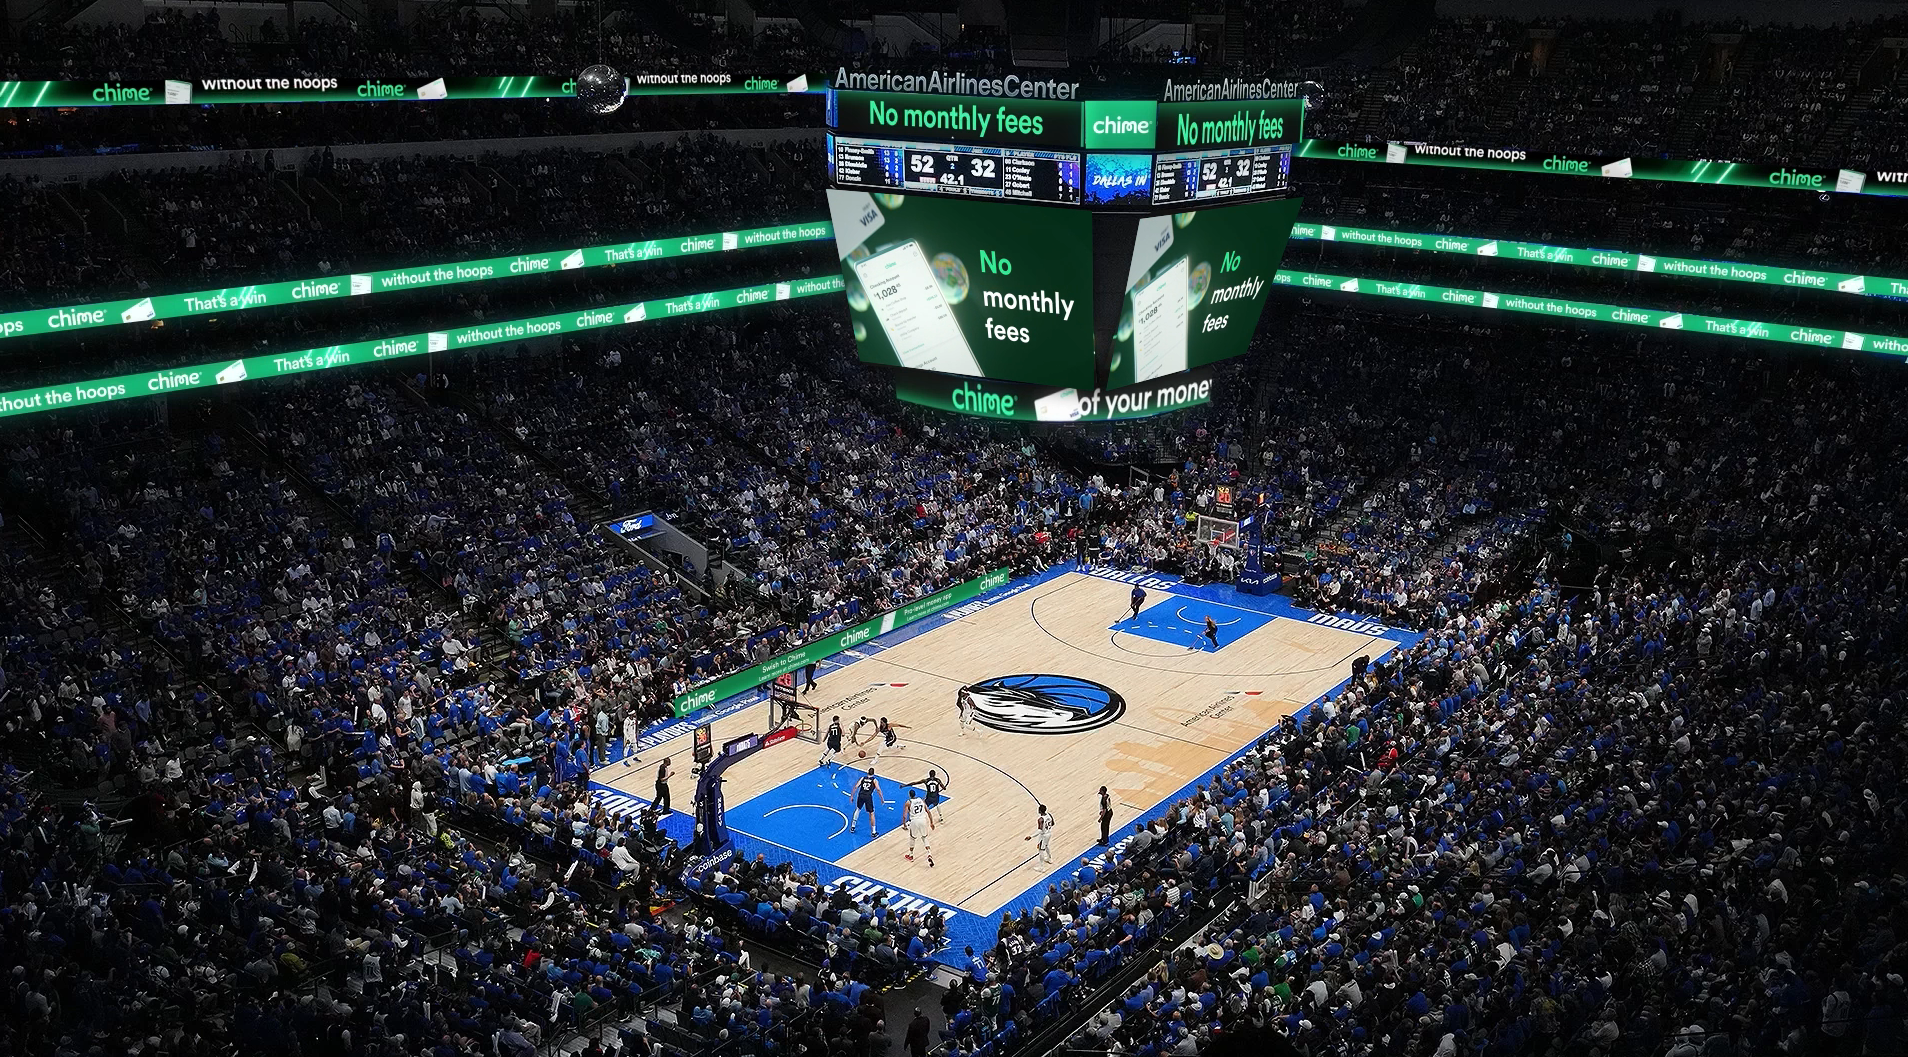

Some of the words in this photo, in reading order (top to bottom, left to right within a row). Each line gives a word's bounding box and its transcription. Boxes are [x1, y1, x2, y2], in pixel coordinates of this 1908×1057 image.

[202, 78, 262, 90] without
[266, 77, 290, 90] the
[293, 76, 338, 91] hoops
[637, 75, 678, 85] without
[681, 74, 698, 84] the
[700, 73, 731, 86] hoops
[744, 77, 778, 90] chime
[835, 67, 1079, 99] AmericanAirlinesCenter
[92, 83, 151, 102] chime
[357, 80, 404, 97] chime
[1163, 78, 1299, 102] AmericanAirlinesCenter
[869, 100, 898, 126] No
[904, 104, 991, 137] monthly
[996, 106, 1043, 135] fees
[1093, 116, 1150, 134] chime
[1177, 113, 1198, 146] No
[1201, 110, 1256, 146] monthly
[1259, 109, 1284, 139] fees
[1338, 143, 1377, 159] chime
[1415, 145, 1462, 157] without
[1464, 146, 1485, 159] the
[1487, 148, 1527, 162] hoops
[910, 154, 935, 174] 52
[970, 158, 996, 178] 32
[1201, 162, 1218, 181] 52
[1235, 158, 1251, 177] 32
[1543, 155, 1588, 172] chime
[940, 172, 965, 186] 42.1
[1092, 174, 1133, 189] DALLAS
[1134, 173, 1148, 187] IN
[1769, 168, 1822, 187] chime
[859, 209, 878, 227] VISA
[744, 231, 780, 244] without
[782, 227, 797, 240] the
[799, 225, 826, 240] hoops
[1291, 225, 1315, 237] hime
[1342, 230, 1378, 244] without
[1378, 233, 1393, 244] the
[1394, 236, 1422, 249] hoops
[680, 238, 714, 254] chime
[1154, 232, 1170, 252] VISA
[1435, 238, 1468, 252] chime
[605, 246, 634, 262] That's
[636, 250, 643, 258] a
[1220, 250, 1241, 273] No
[1517, 247, 1545, 260] That's
[1547, 252, 1553, 260] a
[1591, 252, 1629, 268] chime
[510, 257, 549, 273] chime
[980, 250, 1012, 275] No
[382, 271, 431, 288] without
[433, 268, 454, 281] the
[456, 265, 494, 280] hoops
[1663, 260, 1708, 275] without
[1710, 264, 1729, 277] the
[1731, 267, 1767, 283] hoops
[1784, 271, 1826, 287] chime
[797, 280, 830, 294] without
[832, 277, 845, 290] the
[1303, 274, 1332, 287] chime
[1375, 283, 1401, 295] That's
[1890, 282, 1908, 295] Tha
[292, 281, 338, 300] chime
[736, 288, 768, 304] chime
[1210, 276, 1264, 304] monthly
[1442, 289, 1475, 303] chime
[184, 295, 227, 312] That's
[230, 297, 238, 307] a
[665, 300, 693, 315] That's
[695, 302, 701, 310] a
[983, 290, 1075, 321] monthly
[1506, 297, 1545, 312] without
[1547, 300, 1563, 312] the
[1565, 302, 1597, 317] hoops
[48, 308, 104, 328] chime
[576, 311, 614, 328] chime
[1202, 313, 1229, 333] fees
[1611, 309, 1649, 324] chime
[457, 327, 502, 344] without
[505, 325, 524, 338] the
[526, 319, 561, 336] hoops
[985, 317, 1030, 343] fees
[1705, 319, 1738, 335] That's
[1739, 325, 1746, 335] a
[1790, 328, 1832, 344] chime
[373, 340, 417, 358] chime
[274, 356, 313, 373] That's
[315, 357, 324, 367] a
[148, 371, 200, 391] chime
[45, 389, 72, 406] the
[76, 383, 126, 402] hoops
[952, 381, 1015, 416] chime
[1081, 388, 1100, 416] of
[1105, 391, 1153, 420] your
[1156, 378, 1212, 409] mone
[1218, 492, 1230, 503] 20
[620, 518, 643, 534] Ford
[980, 573, 1005, 590] chime
[904, 602, 926, 615] Pro-level
[926, 596, 943, 607] money
[943, 592, 952, 601] app
[1307, 613, 1390, 635] MAVS
[840, 626, 870, 647] chime
[762, 661, 779, 673] Swish
[787, 651, 806, 662] Chime
[787, 658, 810, 670] chime.com
[680, 690, 716, 712] chime
[929, 784, 937, 792] 10
[914, 804, 924, 815] 27
[698, 849, 733, 873] coinbase
[1011, 944, 1023, 956] 32
